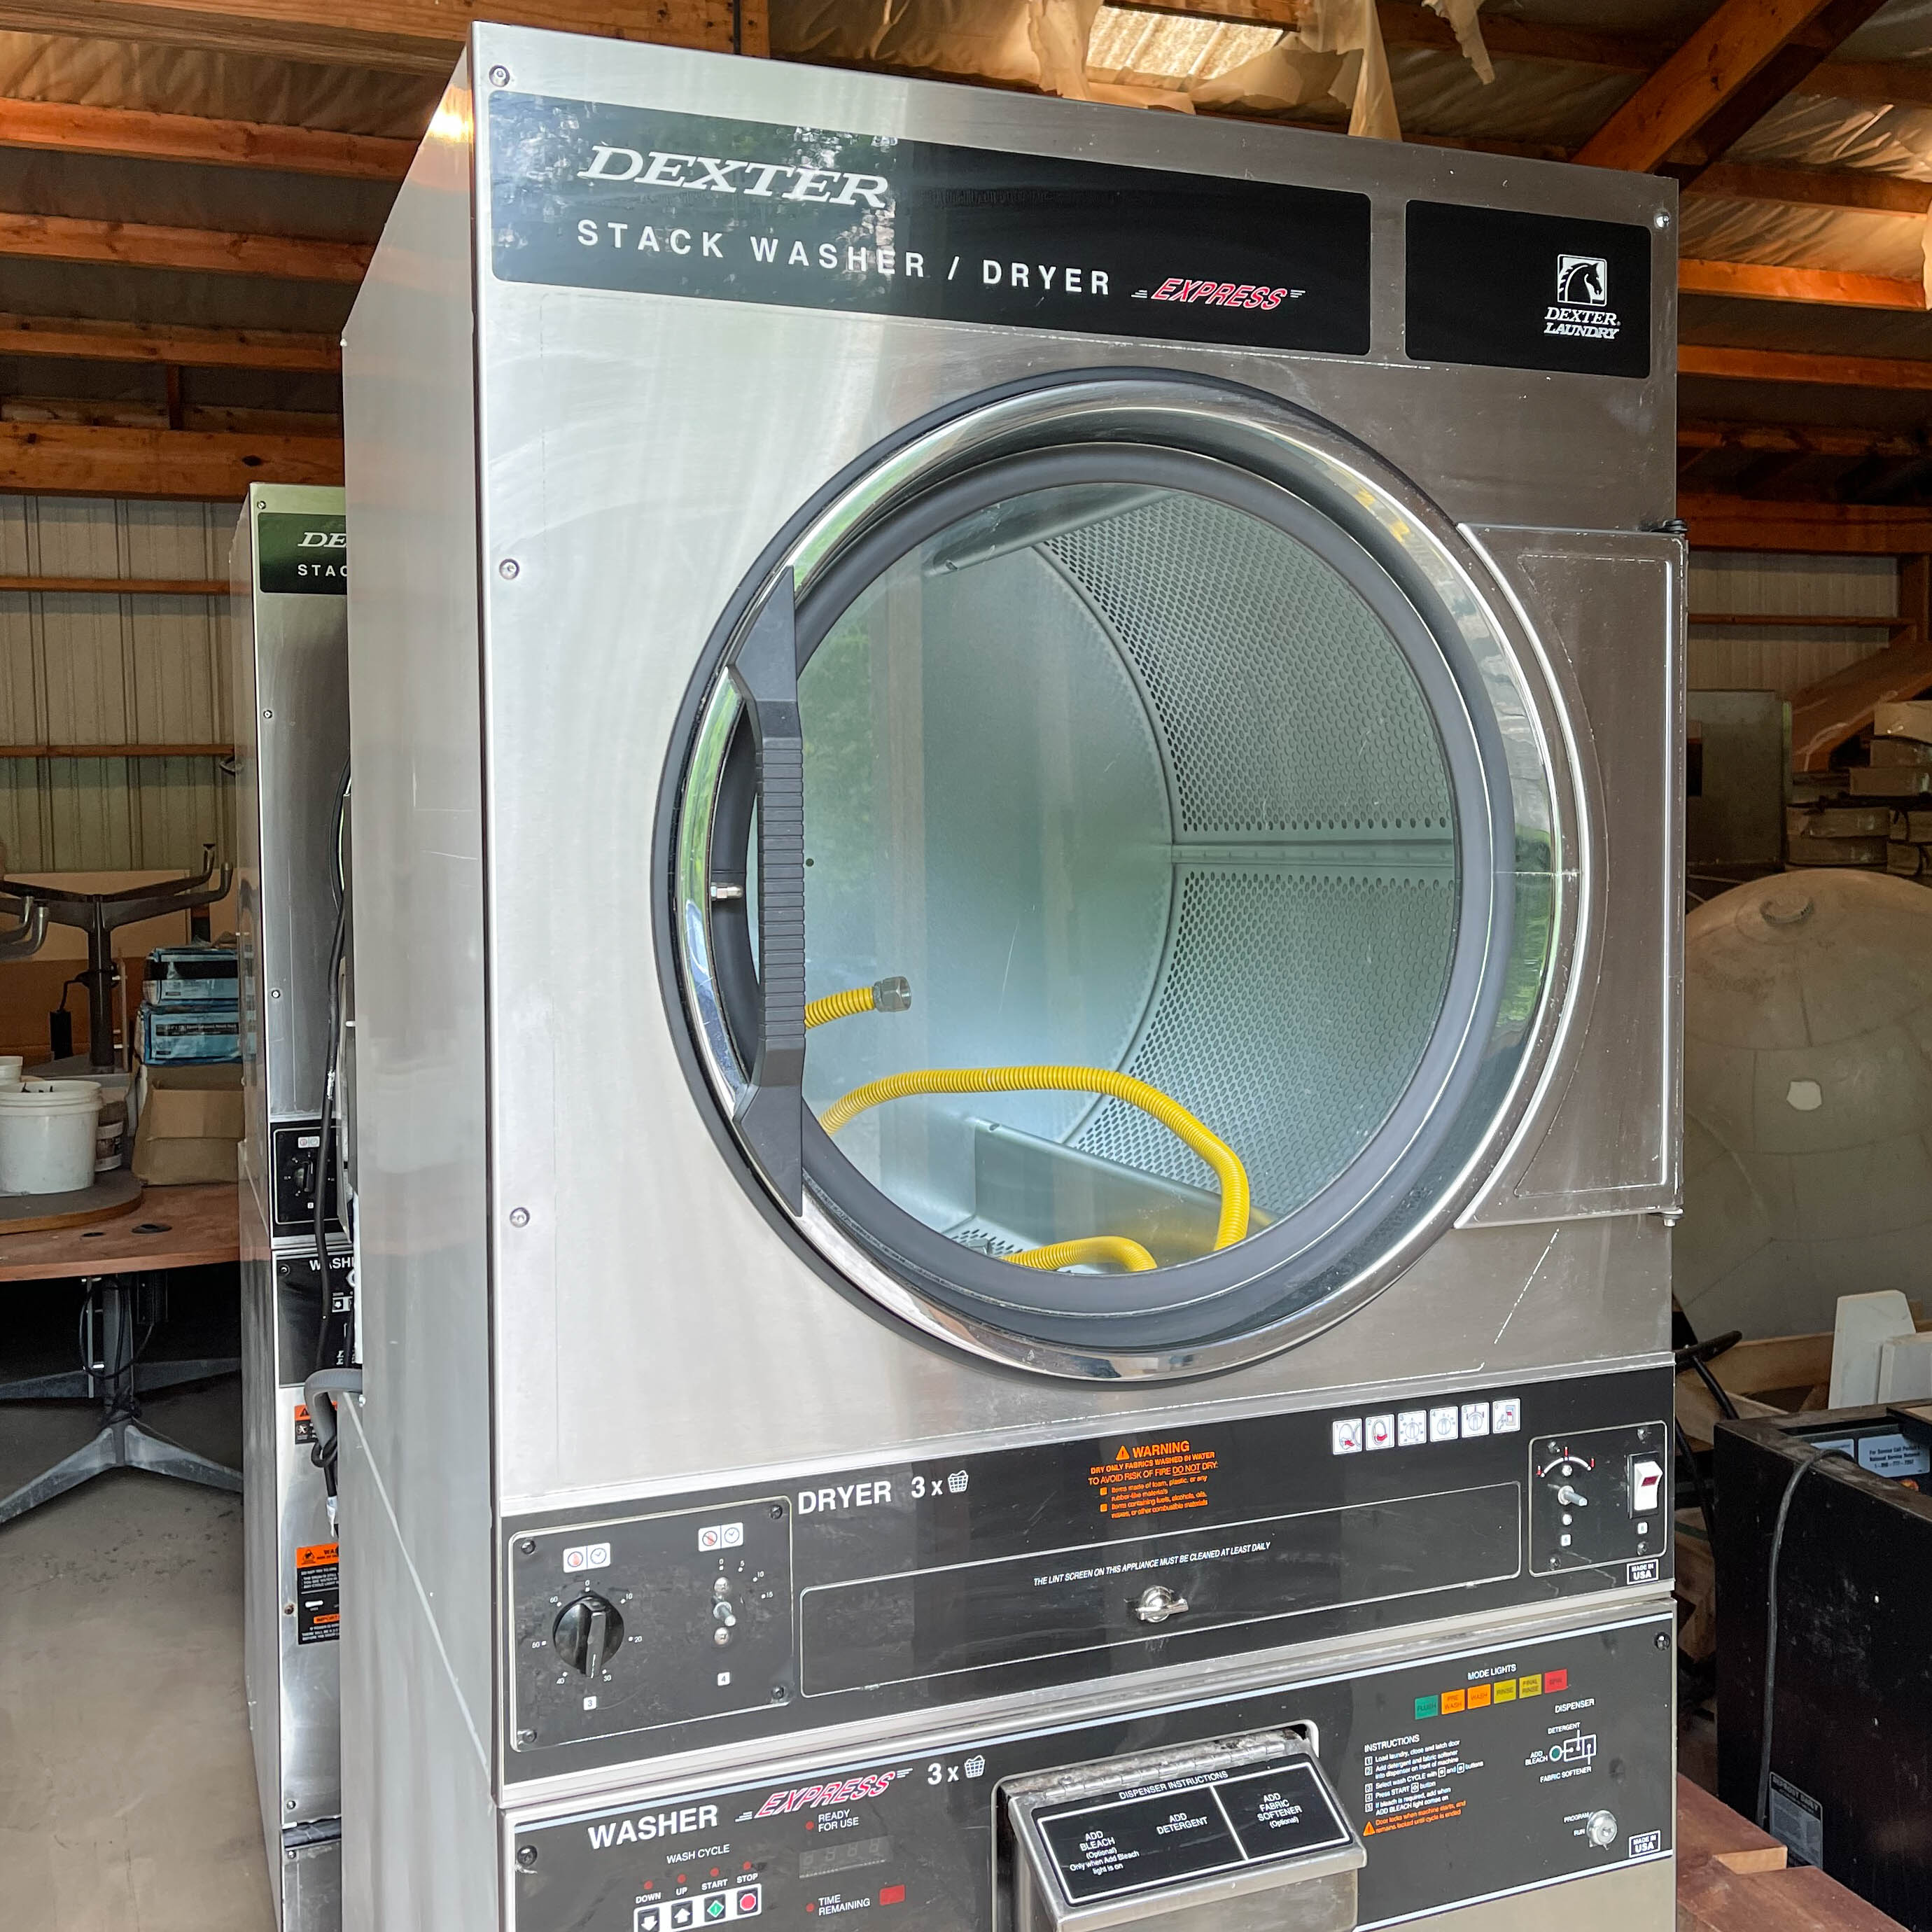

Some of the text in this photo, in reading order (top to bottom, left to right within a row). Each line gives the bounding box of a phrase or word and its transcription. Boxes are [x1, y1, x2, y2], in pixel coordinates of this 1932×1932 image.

[578, 145, 888, 209] DEXTER
[578, 219, 1288, 310] STACK WASHER / DRYER EXPRESS
[1544, 307, 1618, 326] DEXTER
[1544, 322, 1620, 340] LAUNDRY
[298, 564, 347, 577] STAC
[1132, 1440, 1190, 1458] WARNING
[1125, 1460, 1154, 1469] FABRICS
[1155, 1456, 1183, 1466] WASHED
[1088, 1477, 1100, 1485] TO
[1100, 1474, 1124, 1484] AVOID
[1124, 1471, 1142, 1480] RISK
[1143, 1469, 1154, 1478] OF
[1172, 1465, 1184, 1474] DO
[1185, 1463, 1200, 1472] NOT
[798, 1476, 943, 1515] DRYER 3 x
[1034, 1576, 1048, 1586] THE
[1049, 1574, 1064, 1583] LINT
[1065, 1569, 1093, 1581] SCREEN
[1093, 1567, 1105, 1576] ON
[1106, 1565, 1121, 1574] THIS
[1121, 1559, 1158, 1572] APPLIANCE
[1159, 1556, 1179, 1566] MUST
[1180, 1554, 1189, 1562] BE
[1190, 1550, 1220, 1561] CLEANED
[1231, 1544, 1252, 1555] LEAST
[1252, 1541, 1270, 1552] DAILY
[1633, 1570, 1652, 1580] USA
[1468, 1664, 1516, 1680] MODE LIGHTS
[1496, 1687, 1514, 1695] RINSE
[1522, 1686, 1539, 1694] RINSE
[1471, 1693, 1488, 1701] WASH
[1445, 1702, 1462, 1711] WASH
[1555, 1698, 1595, 1713] DISPENSER
[1548, 1722, 1581, 1735] DETERGENT
[1364, 1734, 1420, 1753] INSTRUCTIONS
[1375, 1754, 1388, 1763] Load
[1525, 1755, 1548, 1765] BLEACH
[1407, 1773, 1426, 1782] CYCLE
[1540, 1766, 1592, 1783] FABRIC SOFTENER
[1119, 1771, 1228, 1800] DISPENSER INSTRUCTIONS
[1391, 1786, 1410, 1795] START
[1264, 1793, 1281, 1802] ADD
[587, 1763, 958, 1849] WASHER EXPRESS 3 x
[1259, 1799, 1290, 1812] FABRIC
[1389, 1802, 1412, 1812] BLEACH
[818, 1809, 850, 1823] READY
[1169, 1812, 1187, 1823] ADD
[1257, 1805, 1303, 1821] SOFTENER
[1563, 1812, 1590, 1823] PROGRAM
[818, 1817, 859, 1833] FOR USE
[1156, 1816, 1208, 1835] DETERGENT
[1269, 1816, 1299, 1828] (Optional)
[1085, 1830, 1104, 1841] ADD
[1079, 1837, 1116, 1851] BLEACH
[1635, 1842, 1655, 1853] USA
[666, 1844, 730, 1864] WASH CYCLE
[1086, 1847, 1117, 1859] (Optional)
[1070, 1850, 1140, 1871] Only when Add Bleach
[1092, 1867, 1107, 1875] light
[701, 1879, 728, 1890] START
[736, 1872, 758, 1884] STOP
[676, 1886, 687, 1896] UP
[635, 1892, 662, 1904] DOWN
[818, 1894, 841, 1906] TIME
[818, 1898, 870, 1916] REMAINING
